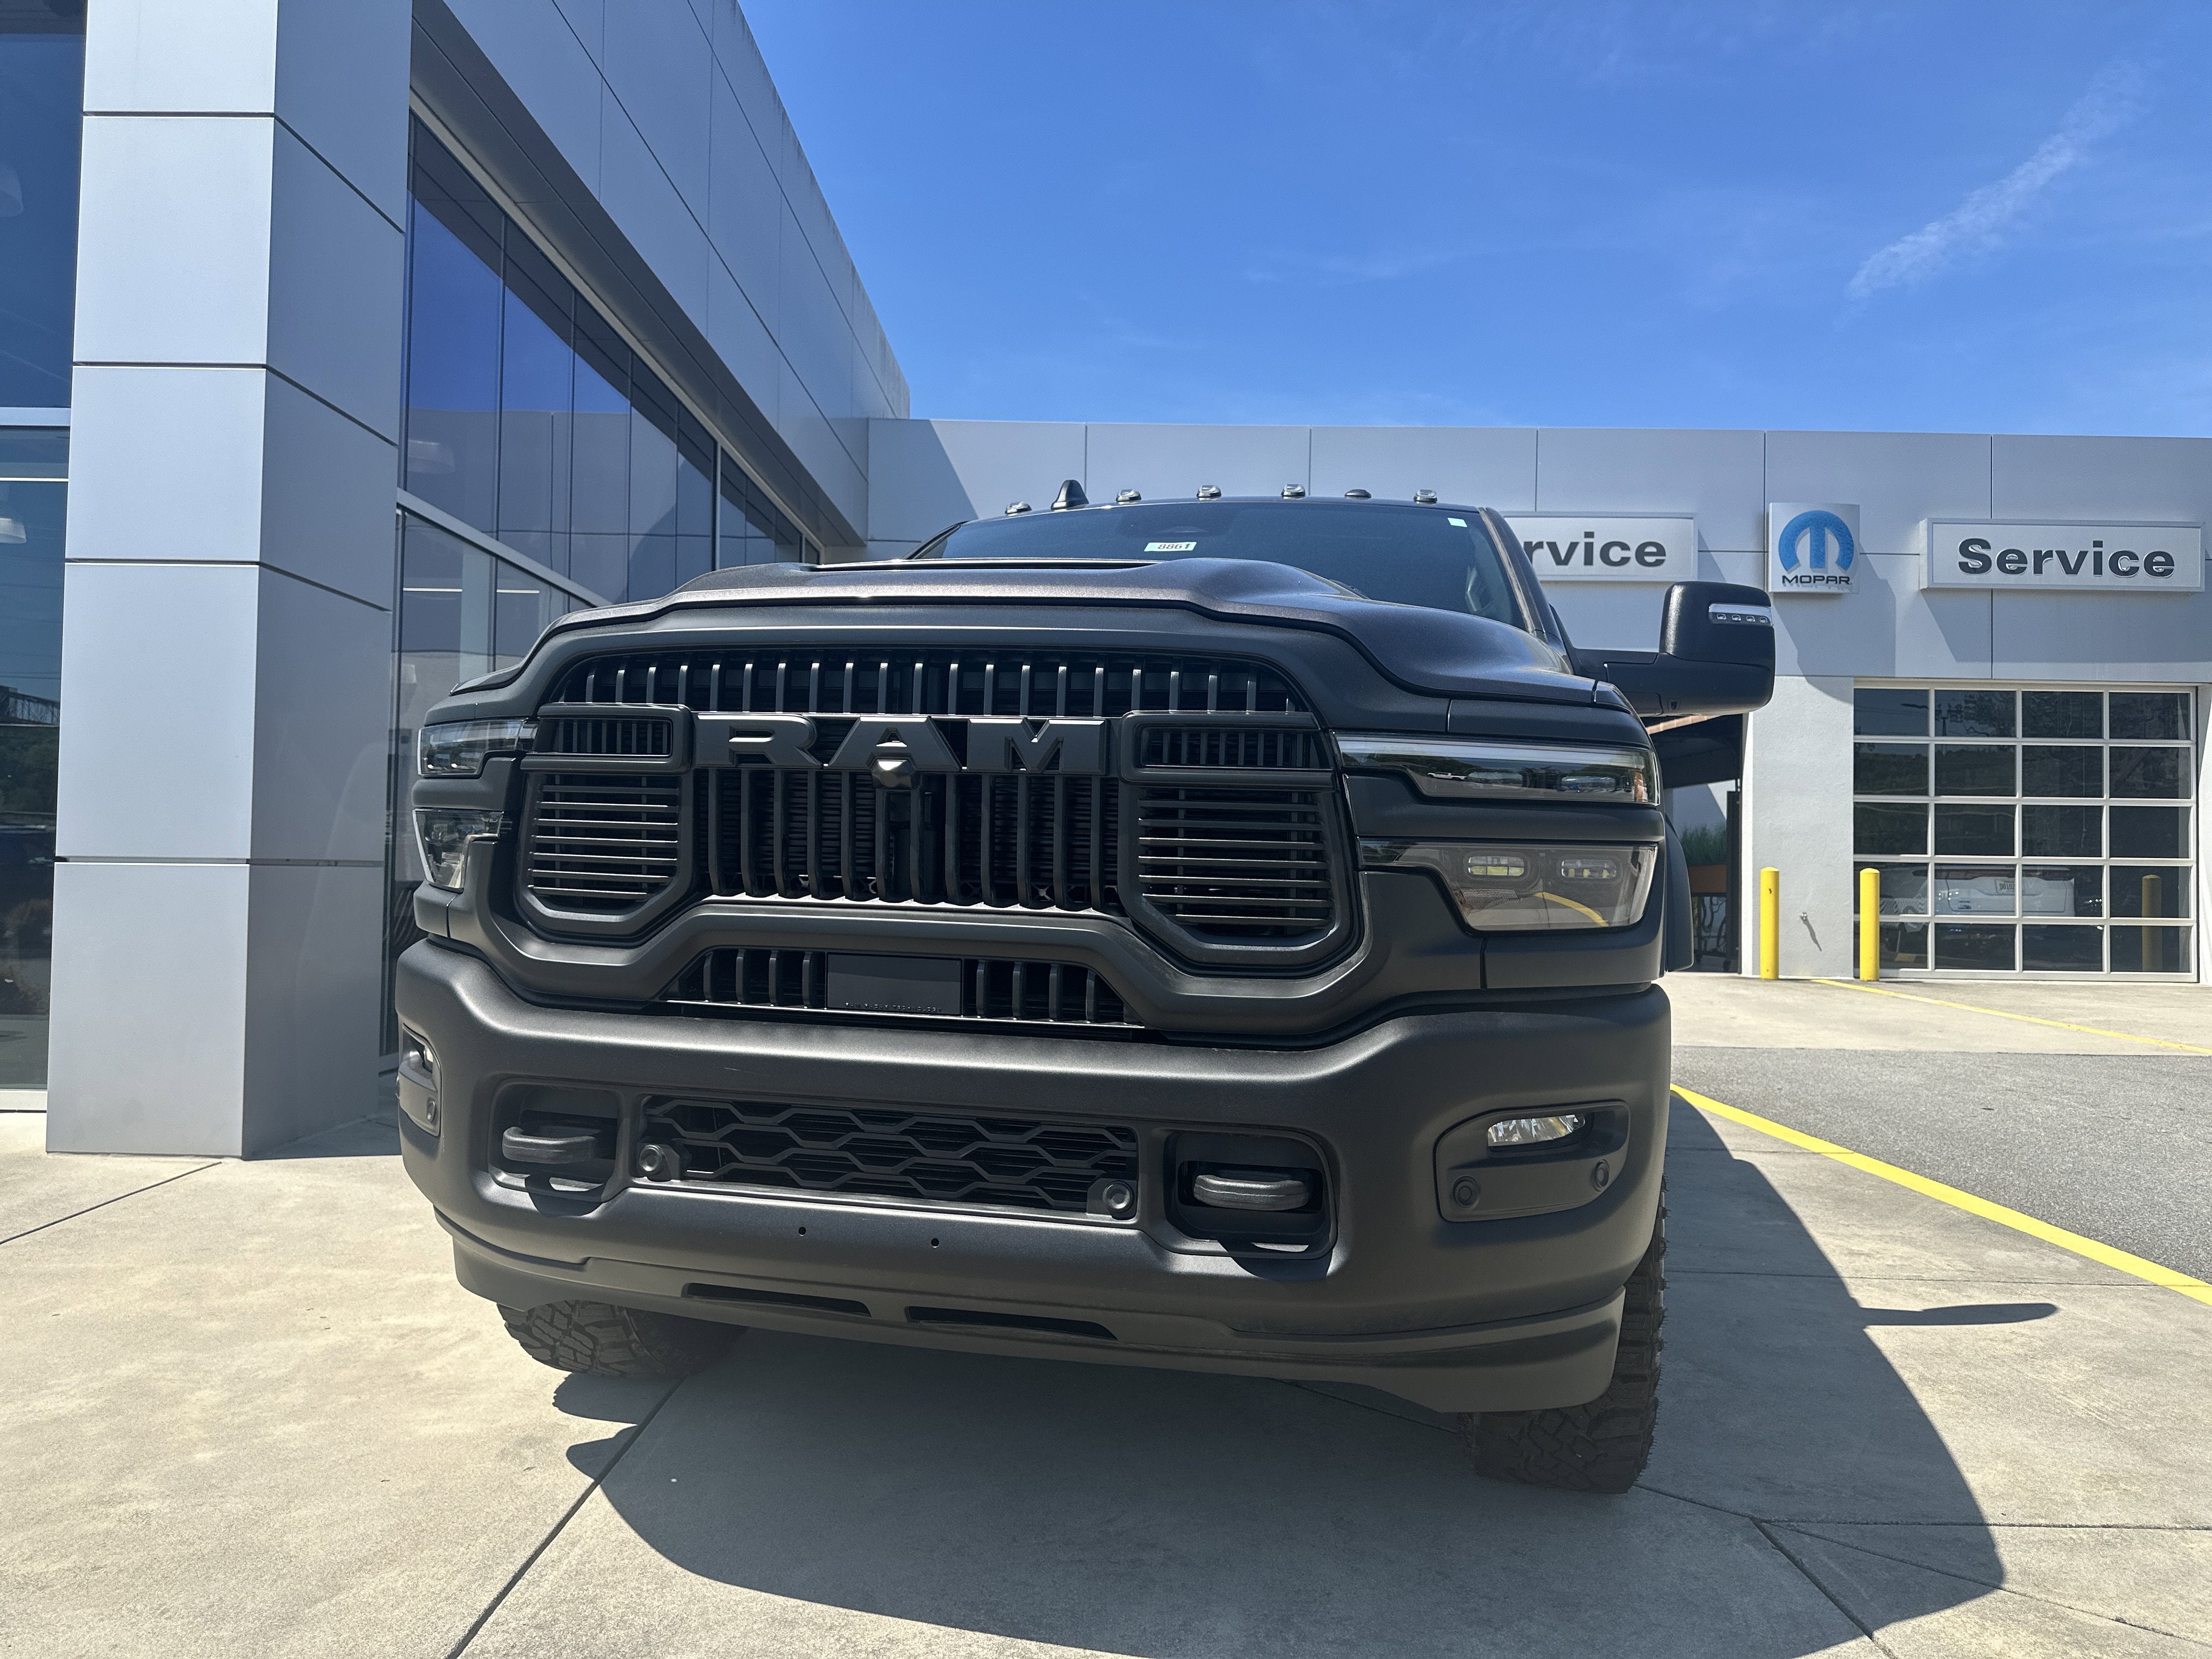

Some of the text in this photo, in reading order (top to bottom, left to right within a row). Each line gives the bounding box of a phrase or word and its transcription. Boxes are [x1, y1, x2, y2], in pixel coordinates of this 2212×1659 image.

[1957, 537, 2175, 578] Service
[1782, 574, 1850, 585] MOPAR
[696, 713, 1106, 775] RAM
